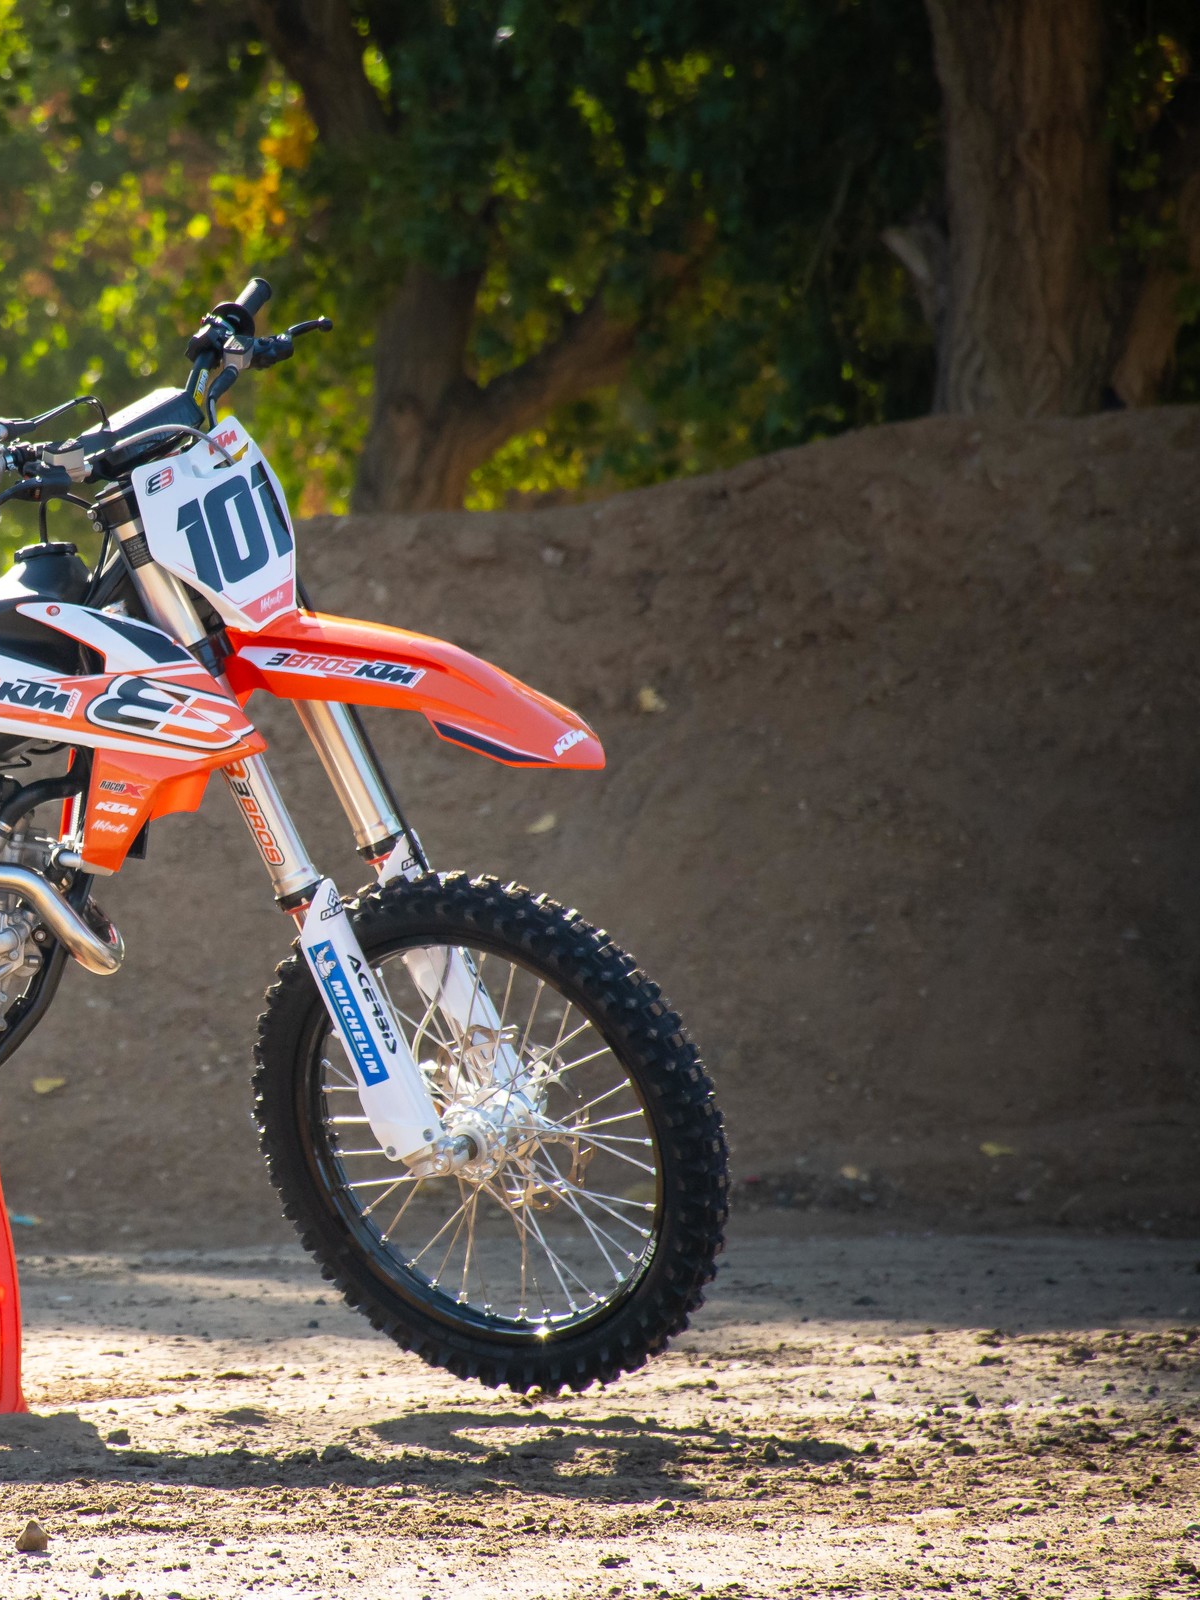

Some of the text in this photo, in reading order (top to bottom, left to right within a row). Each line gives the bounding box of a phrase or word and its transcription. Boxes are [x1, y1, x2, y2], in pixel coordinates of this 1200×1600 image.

[176, 461, 293, 593] 101
[554, 731, 588, 757] KTM
[95, 802, 138, 816] KTM
[330, 980, 380, 1074] MICHELIN
